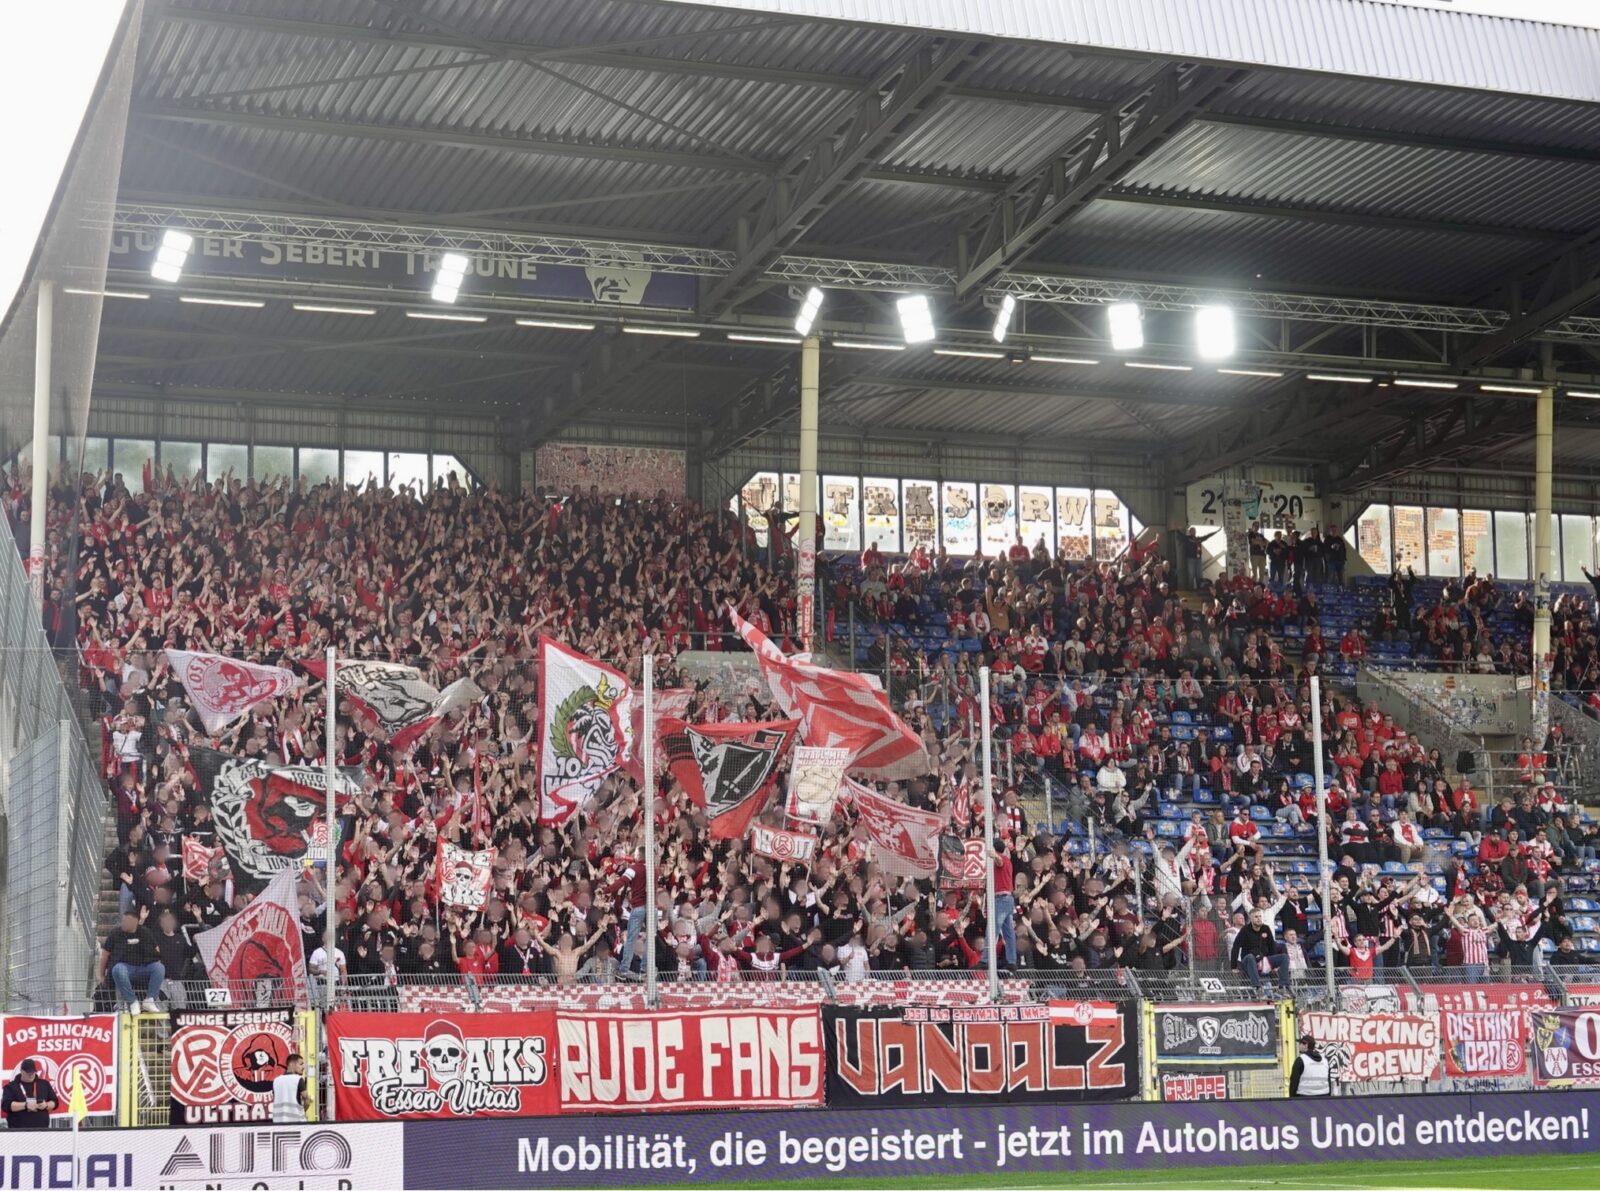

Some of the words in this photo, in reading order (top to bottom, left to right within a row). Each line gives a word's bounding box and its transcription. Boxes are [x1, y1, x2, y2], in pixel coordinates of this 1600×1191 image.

[209, 991, 227, 1002] 27
[1203, 981, 1221, 990] 26
[177, 1014, 224, 1026] JUNGE
[226, 1010, 289, 1023] ESSENER
[1219, 1011, 1270, 1047] Garde
[1310, 1015, 1435, 1047] WRECKING
[1446, 1010, 1521, 1042] DISTRIKT
[6, 1026, 38, 1047] LOS
[40, 1023, 112, 1043] HINCHAS
[37, 1038, 83, 1052] ESSEN
[339, 1037, 546, 1087] FREAKS
[557, 1017, 683, 1103] RUDE
[700, 1015, 820, 1100] FANS
[1353, 1049, 1424, 1078] CREW
[371, 1077, 442, 1115] Essen
[440, 1078, 520, 1115] Ultras
[1163, 1075, 1226, 1101] GRUPPE
[159, 1130, 352, 1176] AUTO
[517, 1134, 696, 1174] Mobilität,
[710, 1131, 766, 1166] die
[780, 1127, 963, 1171] begeistert
[997, 1123, 1071, 1165] jetzt
[1083, 1123, 1124, 1155] im
[1136, 1119, 1300, 1153] Autohaus
[1310, 1114, 1405, 1149] Unold
[1416, 1108, 1589, 1144] entdecken!
